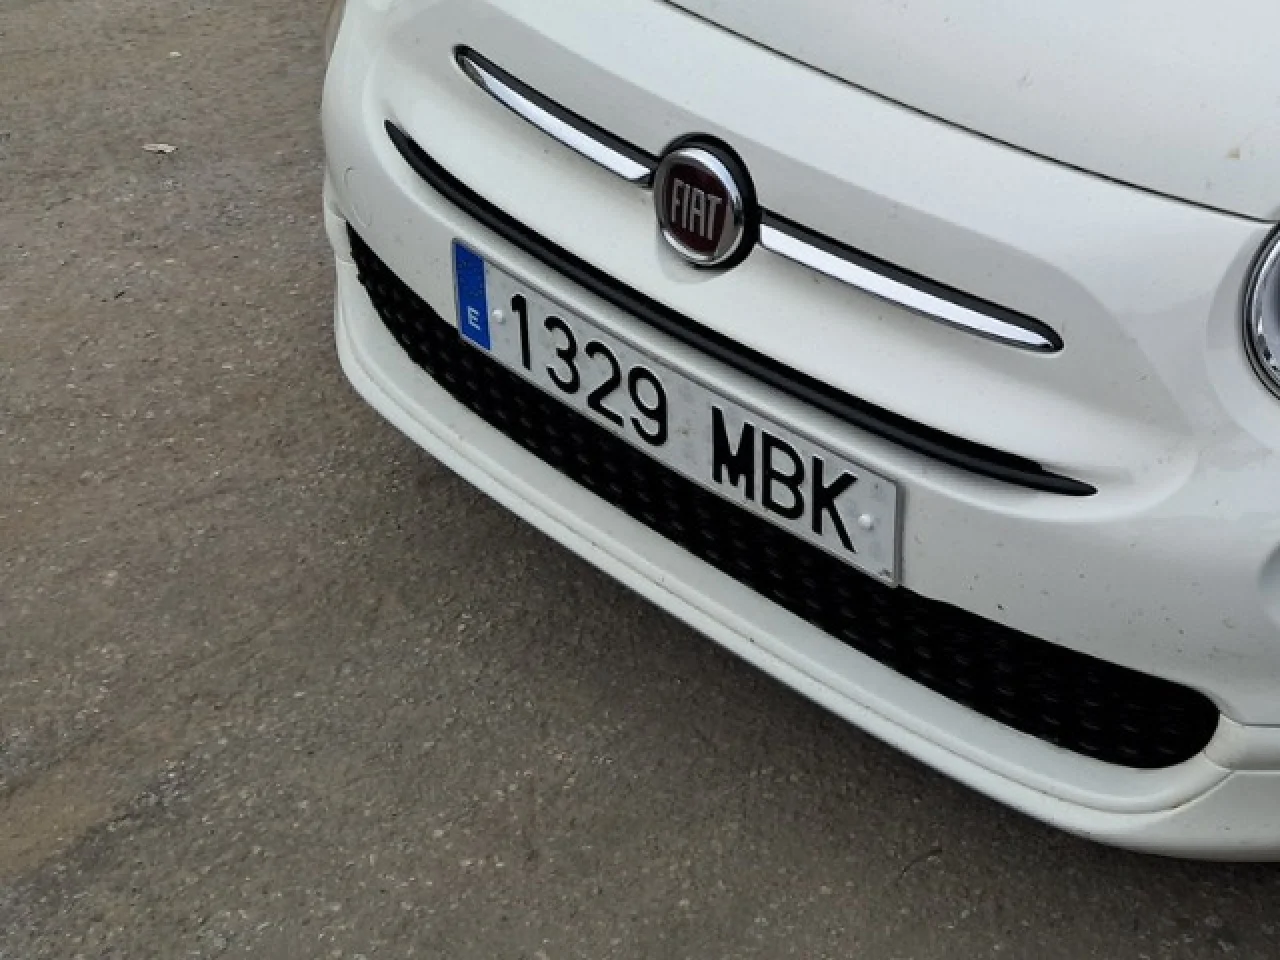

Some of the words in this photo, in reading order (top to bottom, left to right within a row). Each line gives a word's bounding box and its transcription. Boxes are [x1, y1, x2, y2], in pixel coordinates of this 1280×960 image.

[671, 177, 723, 241] FIAT
[466, 305, 481, 331] E
[510, 293, 669, 447] 1329
[711, 405, 859, 555] MBK
